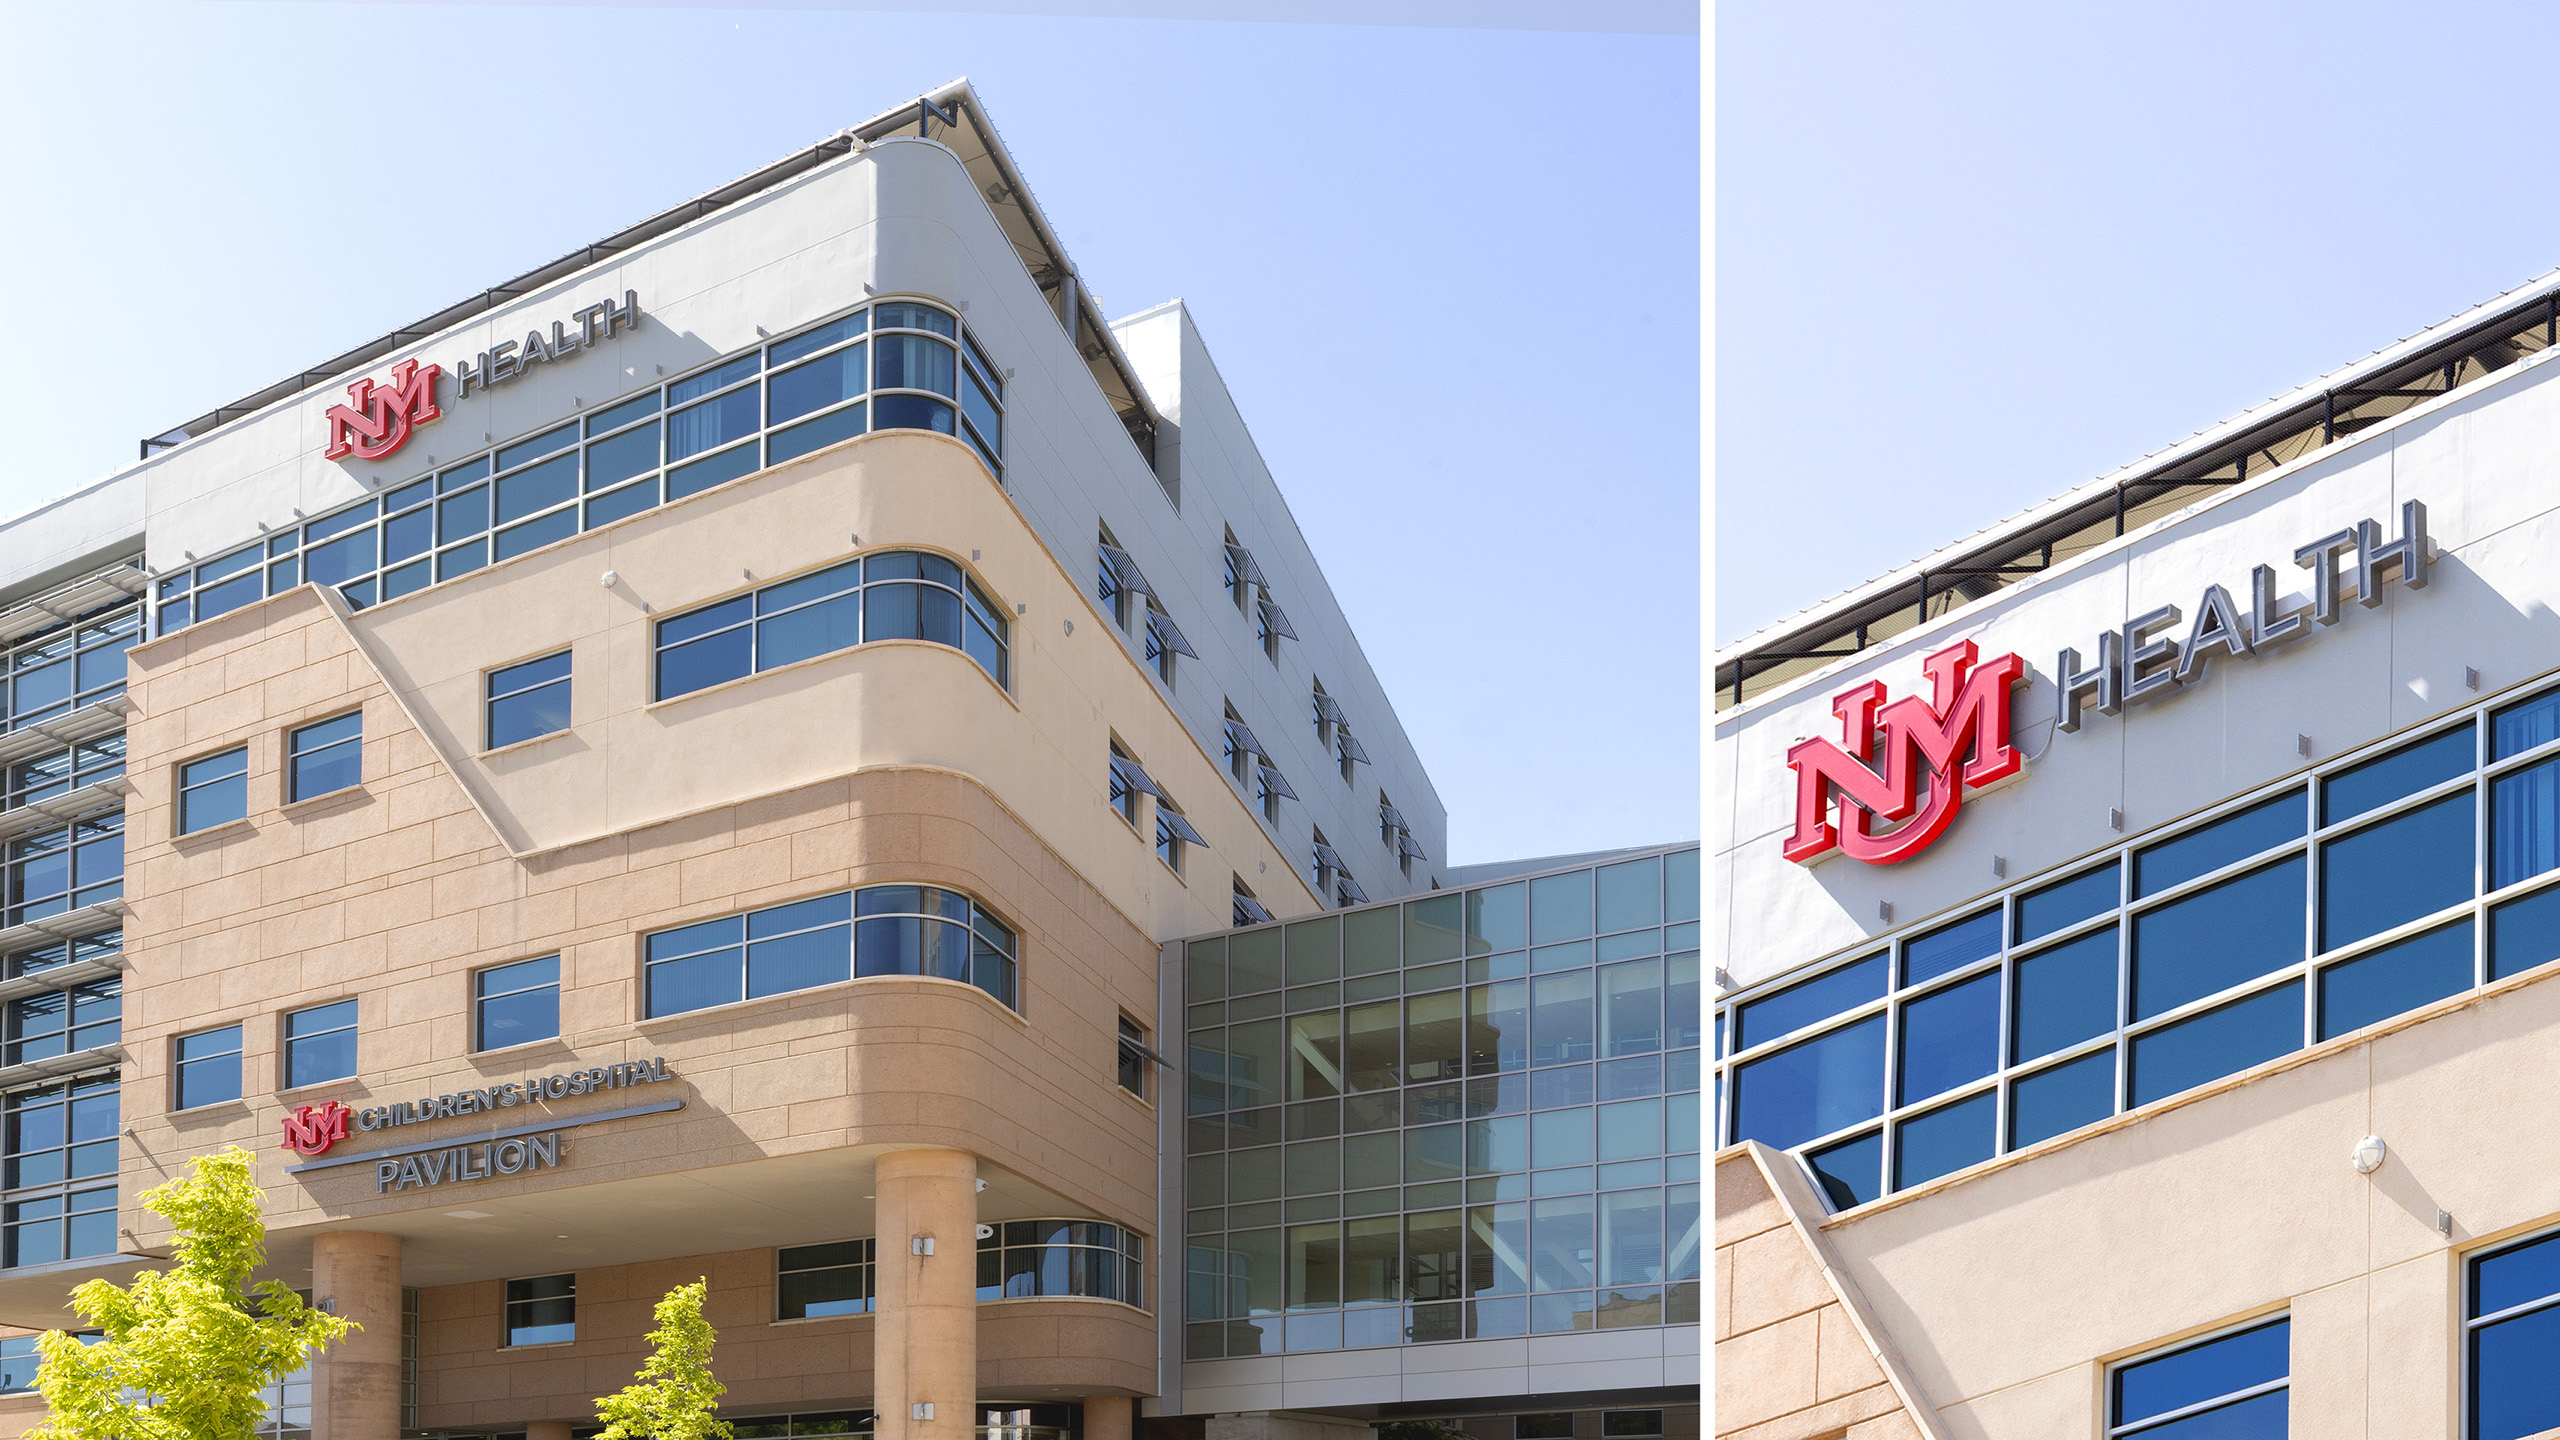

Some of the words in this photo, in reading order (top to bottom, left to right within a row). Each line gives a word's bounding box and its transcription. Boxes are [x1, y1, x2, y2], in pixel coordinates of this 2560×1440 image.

[457, 289, 638, 399] HEALTH
[2057, 498, 2428, 733] HEALTH
[358, 1083, 523, 1131] CHILDREN'S
[529, 1056, 671, 1104] HOSPITAL
[376, 1133, 560, 1194] PAVILION
